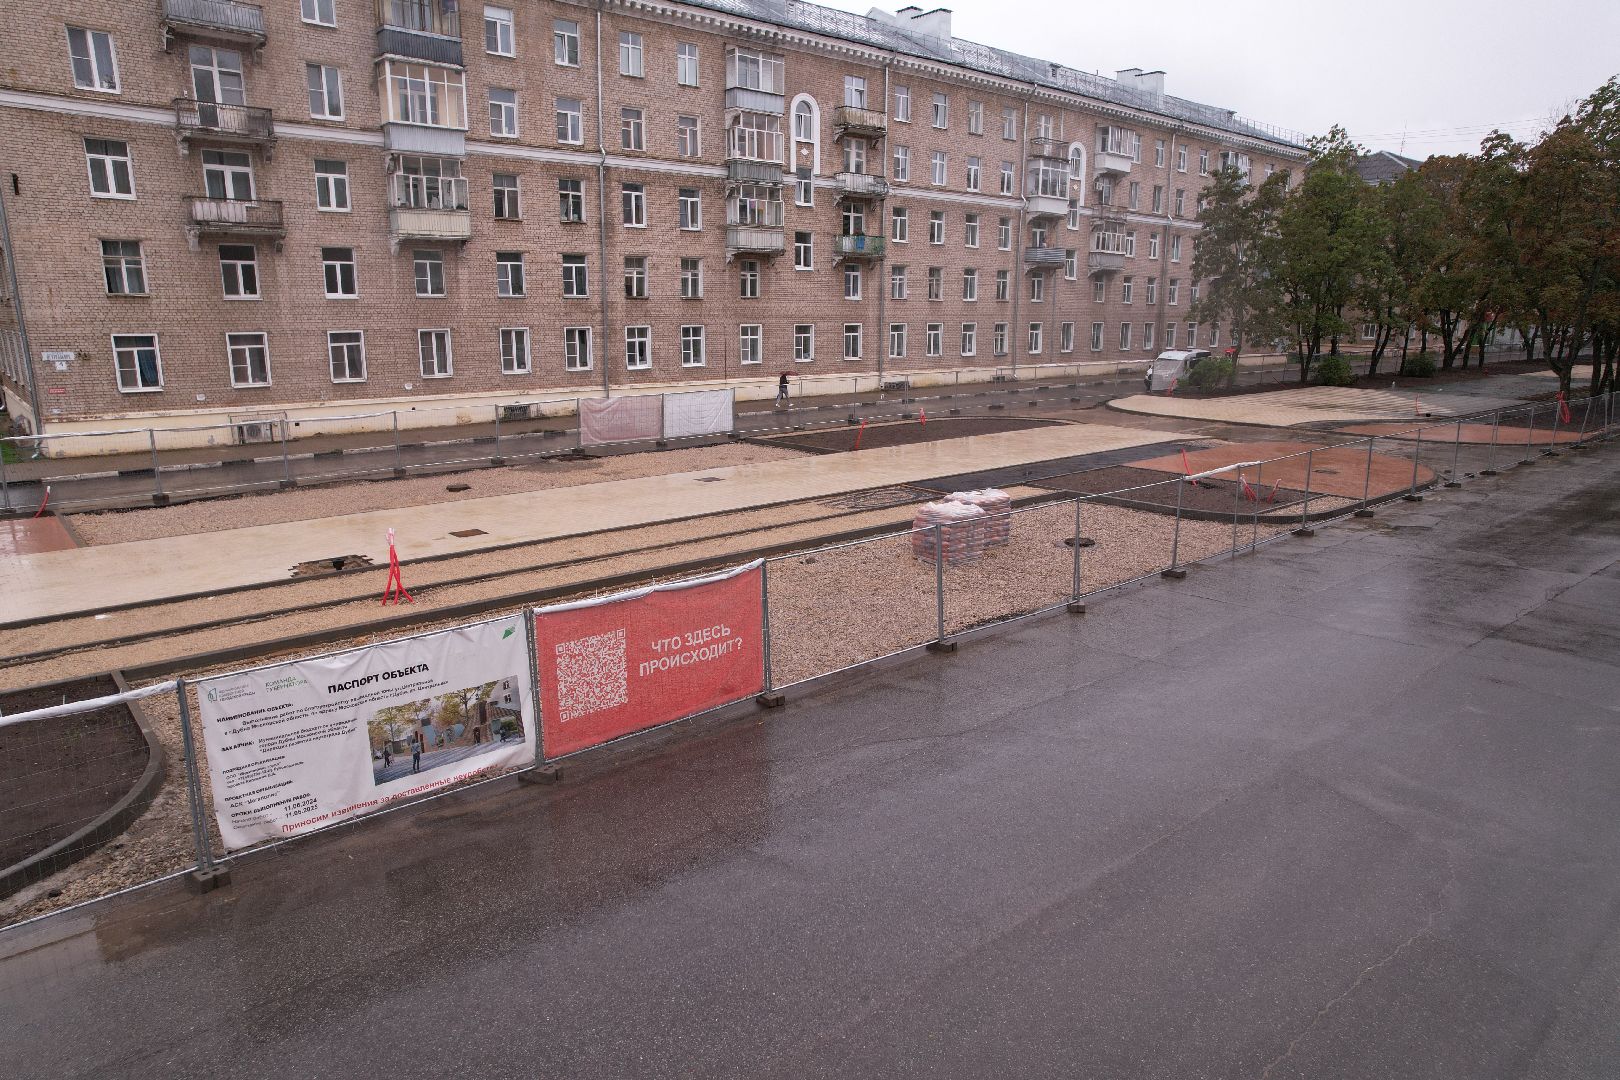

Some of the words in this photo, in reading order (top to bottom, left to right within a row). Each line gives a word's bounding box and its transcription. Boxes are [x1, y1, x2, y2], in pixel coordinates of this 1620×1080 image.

[651, 636, 682, 653] ЧТО
[685, 624, 731, 647] ЗДЕСЬ
[639, 638, 743, 677] ПРОИСХОДИТ?
[265, 676, 297, 687] КОМАНДА
[266, 679, 308, 692] ГУБЕРНАТОРА
[328, 674, 379, 694] ПАСПОРТ
[382, 663, 430, 680] ОБЪЕКТА
[281, 813, 329, 833] Приносим
[331, 799, 378, 817] извинения
[380, 795, 390, 804] за
[391, 777, 451, 801] доставленные
